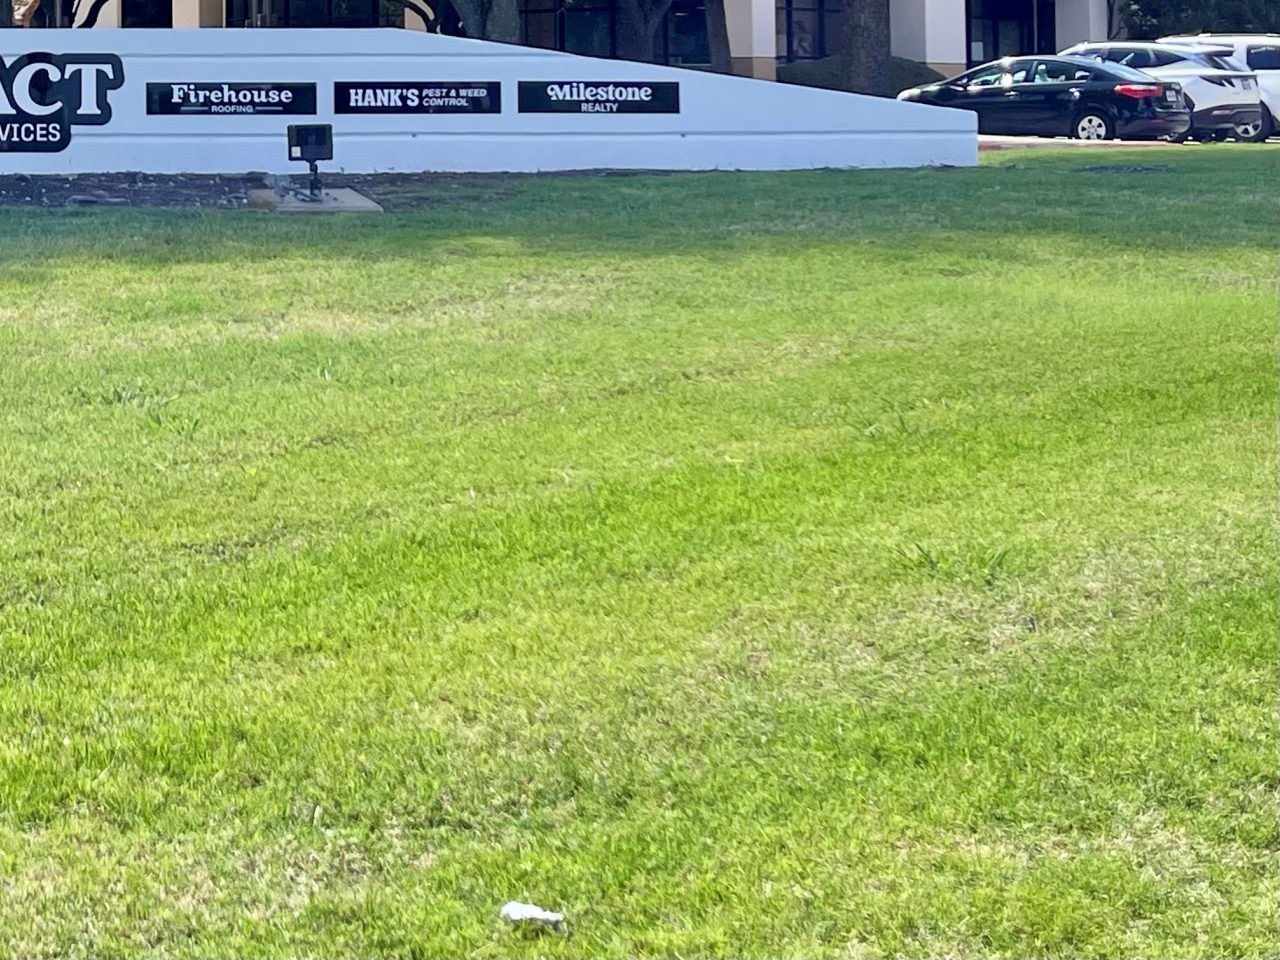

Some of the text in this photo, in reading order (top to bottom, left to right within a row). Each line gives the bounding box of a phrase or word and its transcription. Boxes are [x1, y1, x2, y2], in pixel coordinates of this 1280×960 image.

[170, 84, 293, 103] Firehouse
[422, 88, 488, 98] PEST & WEED
[546, 82, 653, 101] Milestone
[349, 88, 420, 107] HANK'S
[422, 98, 469, 106] CONTROL
[211, 105, 253, 113] ROOFING
[581, 102, 619, 112] REALTY
